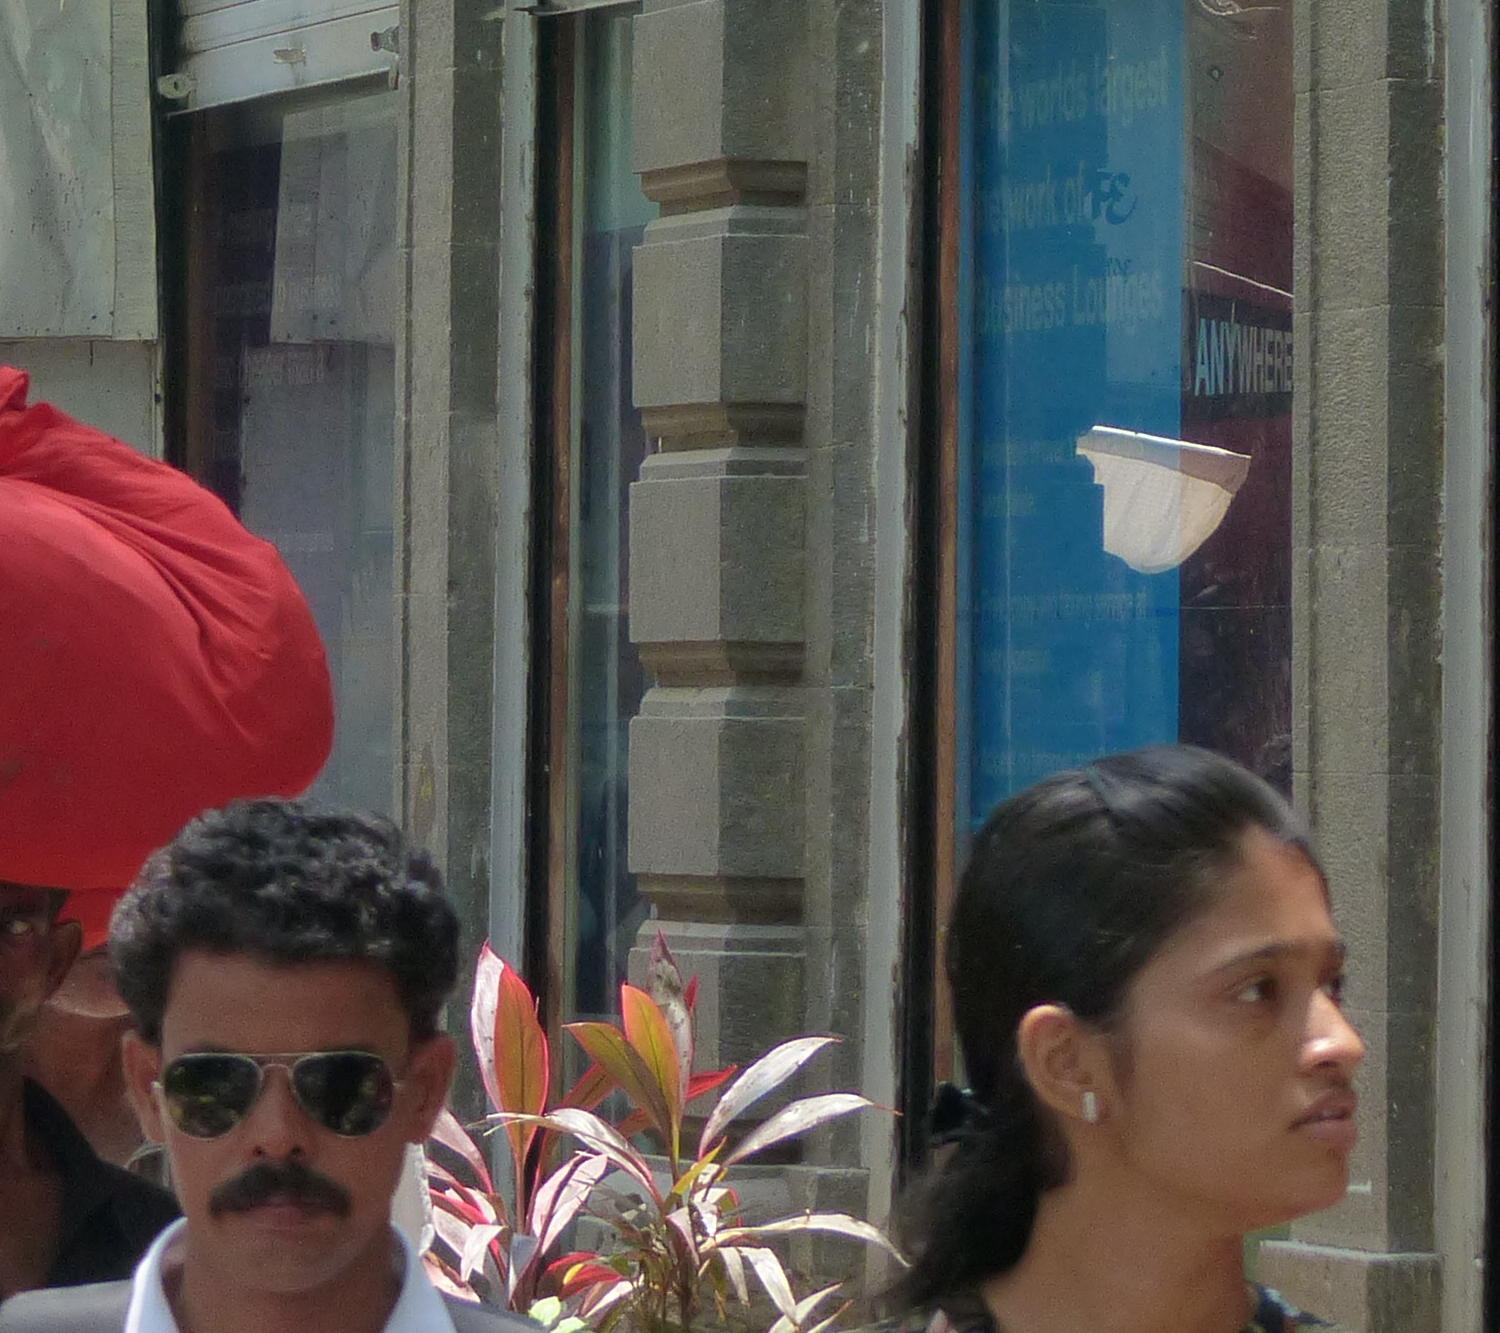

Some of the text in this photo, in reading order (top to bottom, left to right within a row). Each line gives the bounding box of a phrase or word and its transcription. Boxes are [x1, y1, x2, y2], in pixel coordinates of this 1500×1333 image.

[1093, 45, 1169, 128] largest
[1072, 264, 1164, 337] Lounges
[1194, 317, 1294, 396] ANYWHERE
